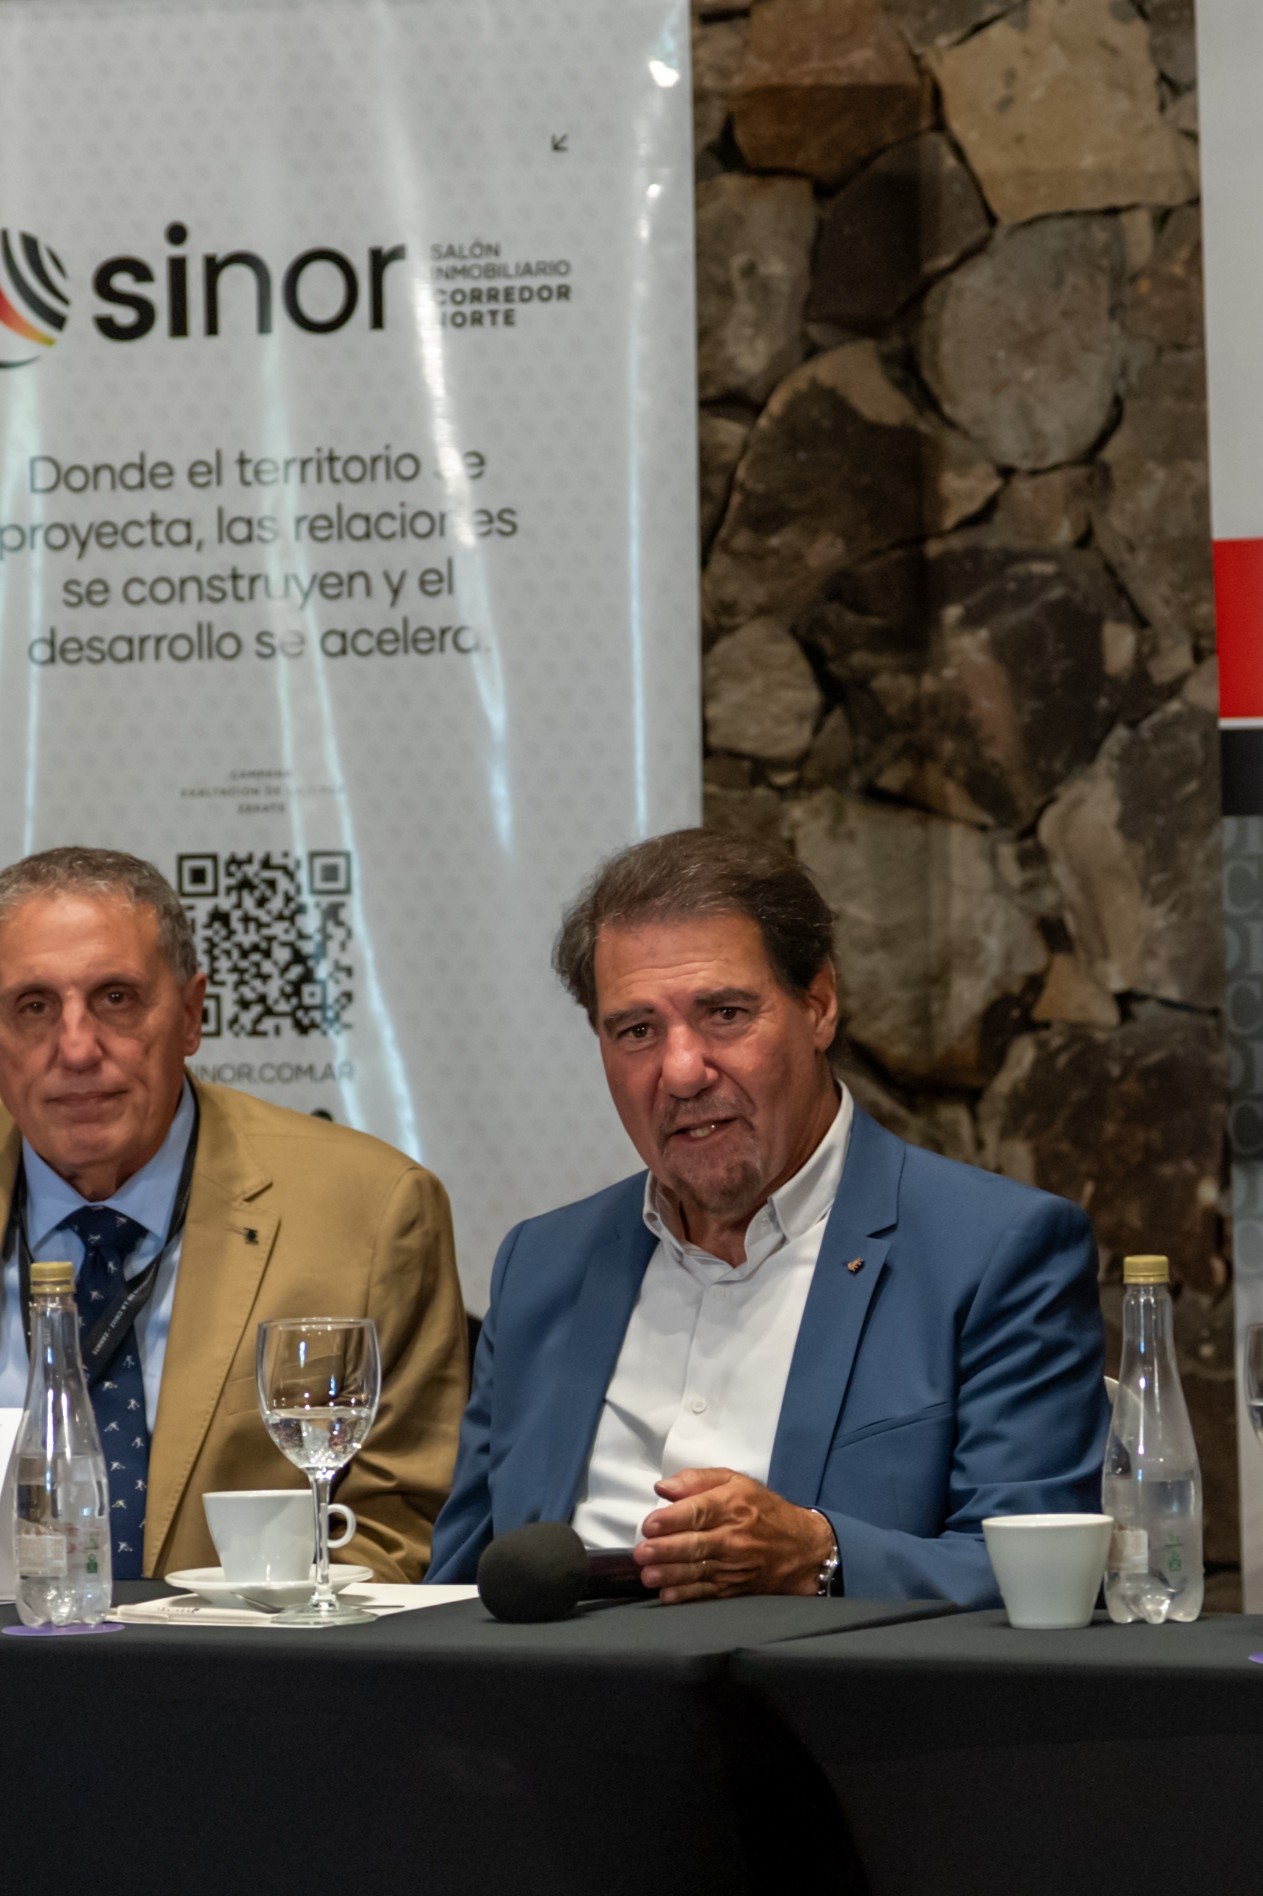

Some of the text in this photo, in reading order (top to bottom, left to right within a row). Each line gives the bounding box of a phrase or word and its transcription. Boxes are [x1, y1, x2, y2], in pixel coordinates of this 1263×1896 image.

[431, 239, 500, 259] SALÓN
[432, 259, 570, 280] INMOBILIARIO
[91, 221, 406, 342] sinor
[28, 445, 485, 494] Donde el territorio e
[217, 507, 279, 545] las
[63, 556, 455, 611] se construyen y el
[28, 620, 242, 667] desarrollo
[255, 629, 305, 660] se
[194, 1062, 355, 1083] INOR.COM.AR
